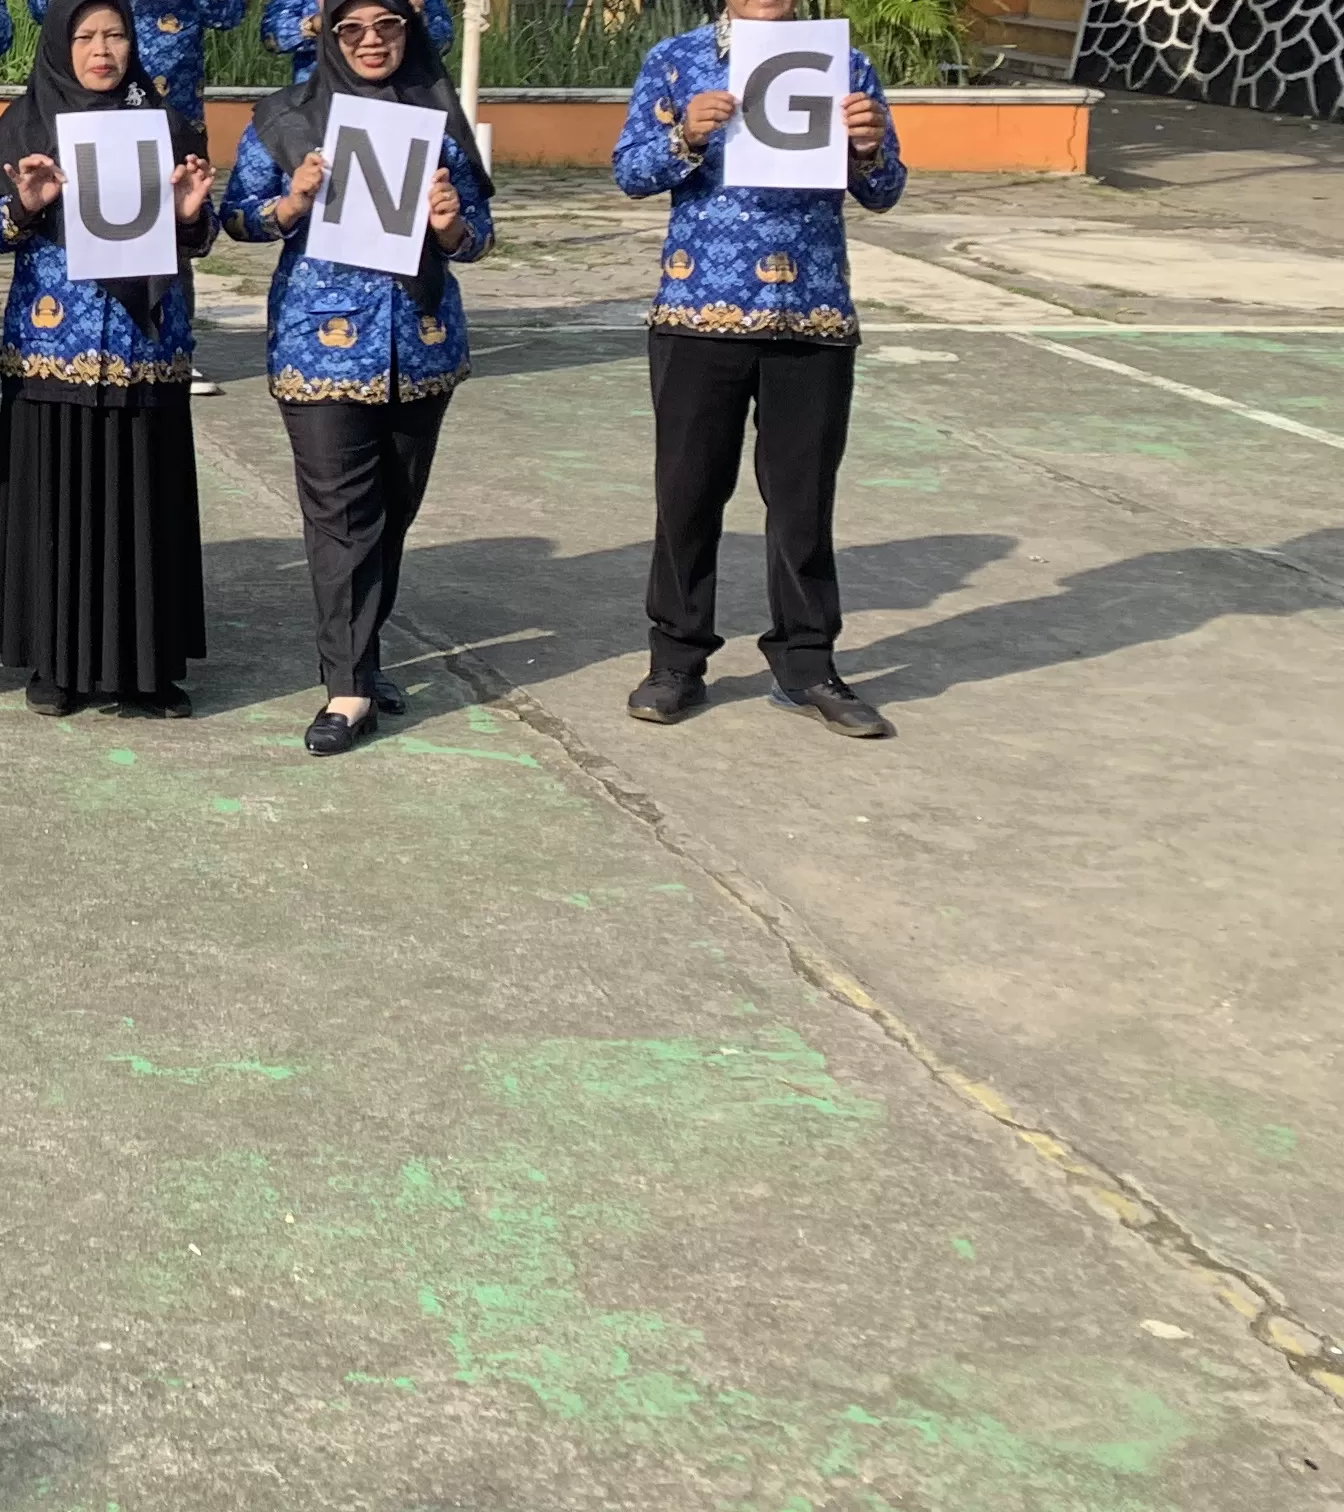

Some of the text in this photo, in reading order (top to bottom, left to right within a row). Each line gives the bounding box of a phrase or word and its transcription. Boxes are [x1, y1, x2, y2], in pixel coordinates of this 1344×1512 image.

[743, 50, 834, 150] G
[75, 140, 161, 241] U
[322, 125, 430, 237] N
